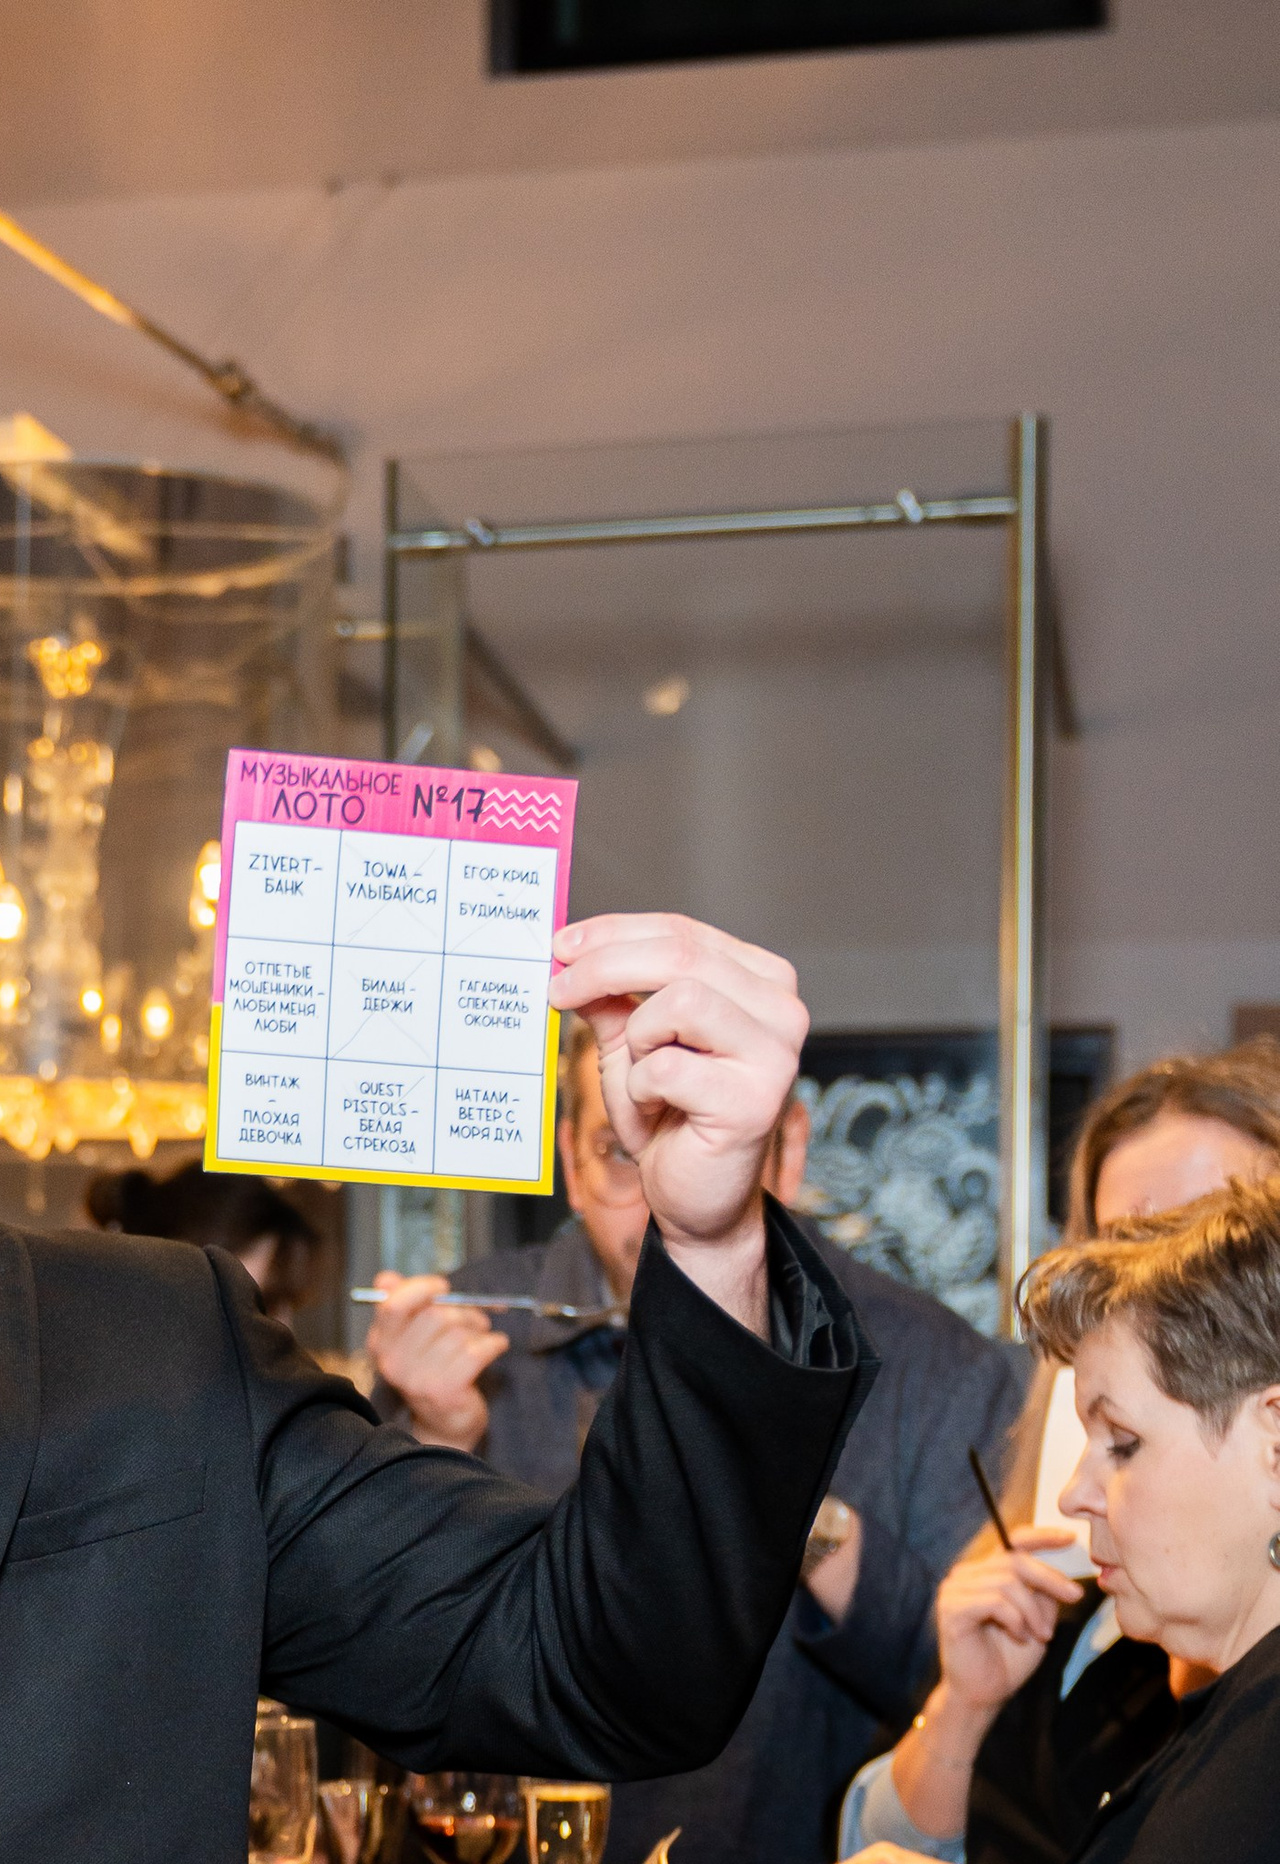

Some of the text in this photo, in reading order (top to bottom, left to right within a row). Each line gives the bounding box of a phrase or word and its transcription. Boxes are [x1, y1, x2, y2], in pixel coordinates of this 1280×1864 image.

[241, 761, 402, 796] МУЗЫКАЛЬНОЕ
[272, 789, 366, 825] ЛОТО
[364, 860, 407, 879] IOWA
[464, 865, 540, 886] ЕГОР КРИД
[264, 878, 304, 896] БАНК
[346, 882, 437, 905] УЛЫБАЙСЯ
[459, 902, 541, 922] БУДИЛЬНИК
[245, 961, 312, 979] ОТПЕТЫЕ
[229, 979, 313, 997] МОШЕННИКИ
[362, 978, 405, 995] БИЛАН
[460, 979, 519, 996] ГАГАРИНА
[233, 998, 316, 1017] ЛЮБИ МЕНЯ
[363, 998, 413, 1014] ДЕРЖИ
[458, 997, 529, 1014] СПЕКТАКЛЬ
[254, 1018, 297, 1034] ЛЮБИ
[464, 1014, 521, 1029] ОКОНЧЕН
[245, 1073, 300, 1089] ВИНТАЖ
[360, 1081, 404, 1097] QUEST
[456, 1088, 508, 1103] НАТАЛИ
[343, 1099, 407, 1116] PISTOLS
[458, 1107, 502, 1123] ВЕТЕР
[243, 1110, 300, 1127] ПЛОХАЯ
[359, 1118, 402, 1135] БЕЛАЯ
[239, 1128, 302, 1146] ДЕВОЧКА
[450, 1125, 523, 1143] МОРЯ ДУЛ
[343, 1136, 416, 1154] СТРЕКОЗА
